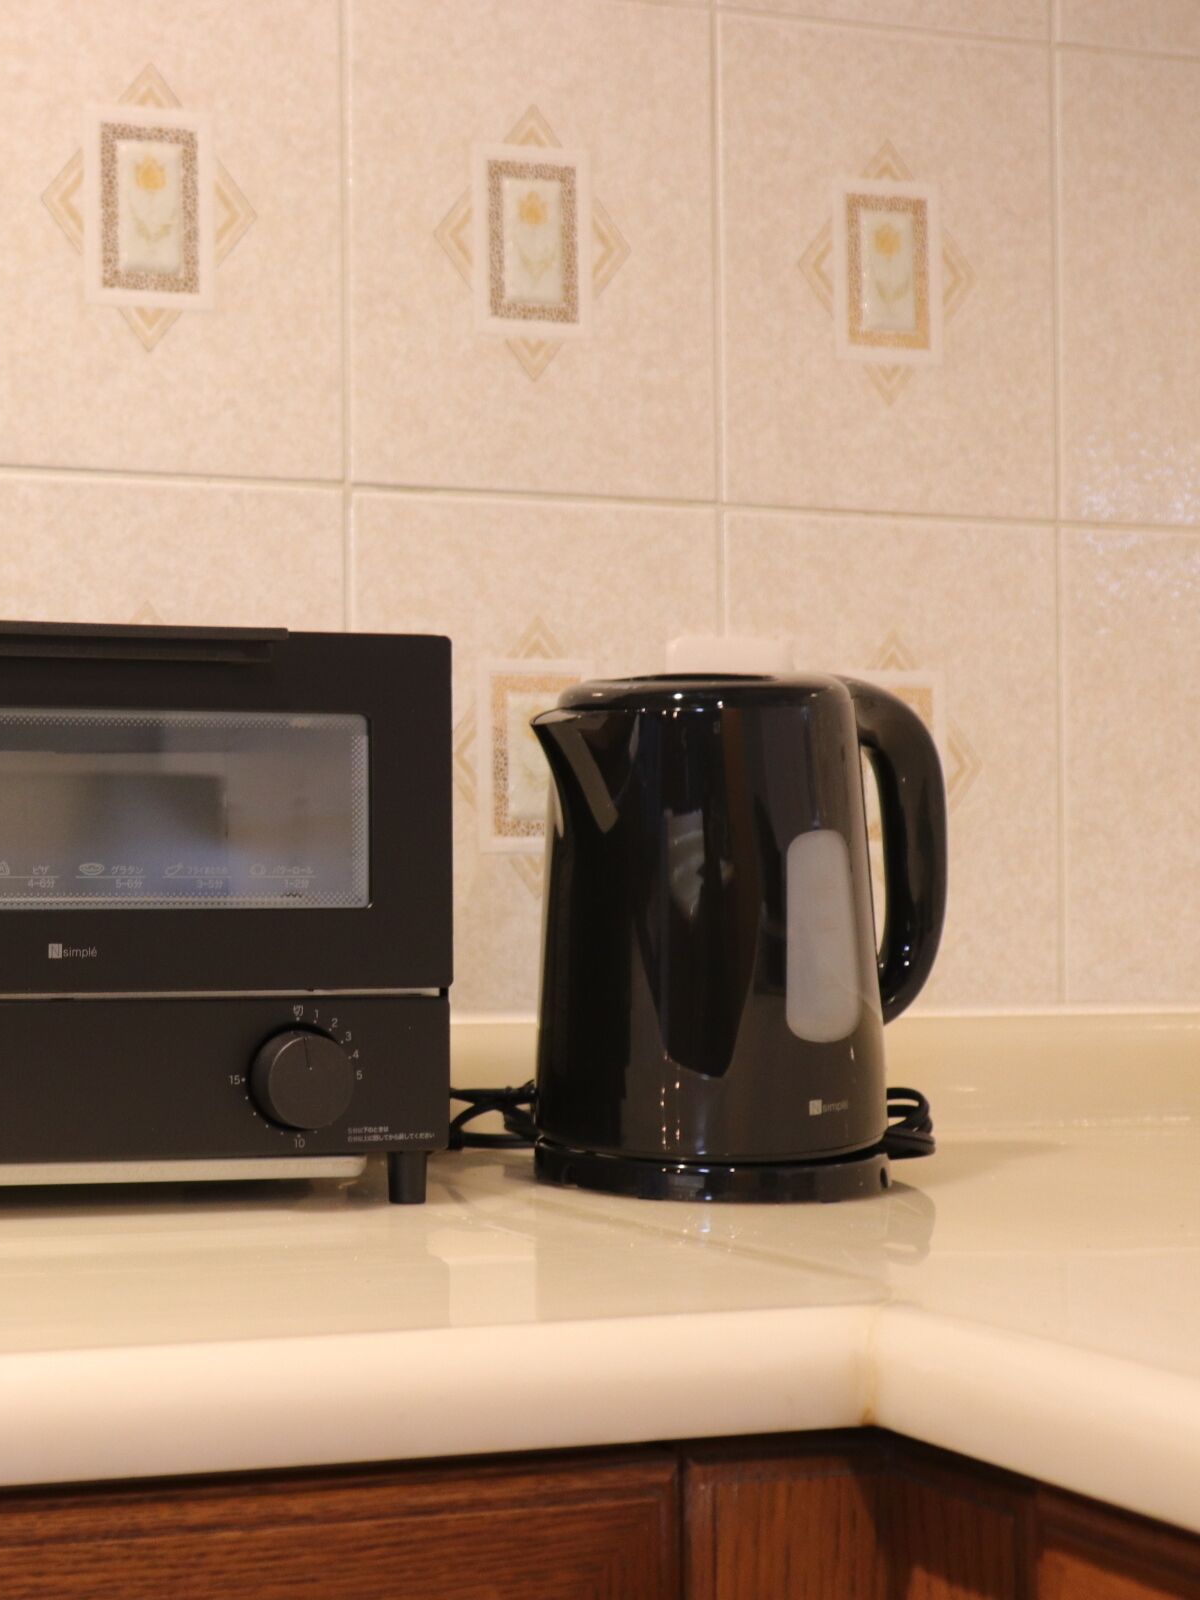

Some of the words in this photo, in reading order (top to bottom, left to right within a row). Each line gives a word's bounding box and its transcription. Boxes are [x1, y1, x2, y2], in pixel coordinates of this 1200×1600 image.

[331, 1018, 339, 1028] 2
[345, 1032, 352, 1041] 3
[352, 1049, 360, 1059] 4
[229, 1075, 241, 1085] 15
[356, 1070, 363, 1080] 5
[294, 1138, 306, 1148] 10
